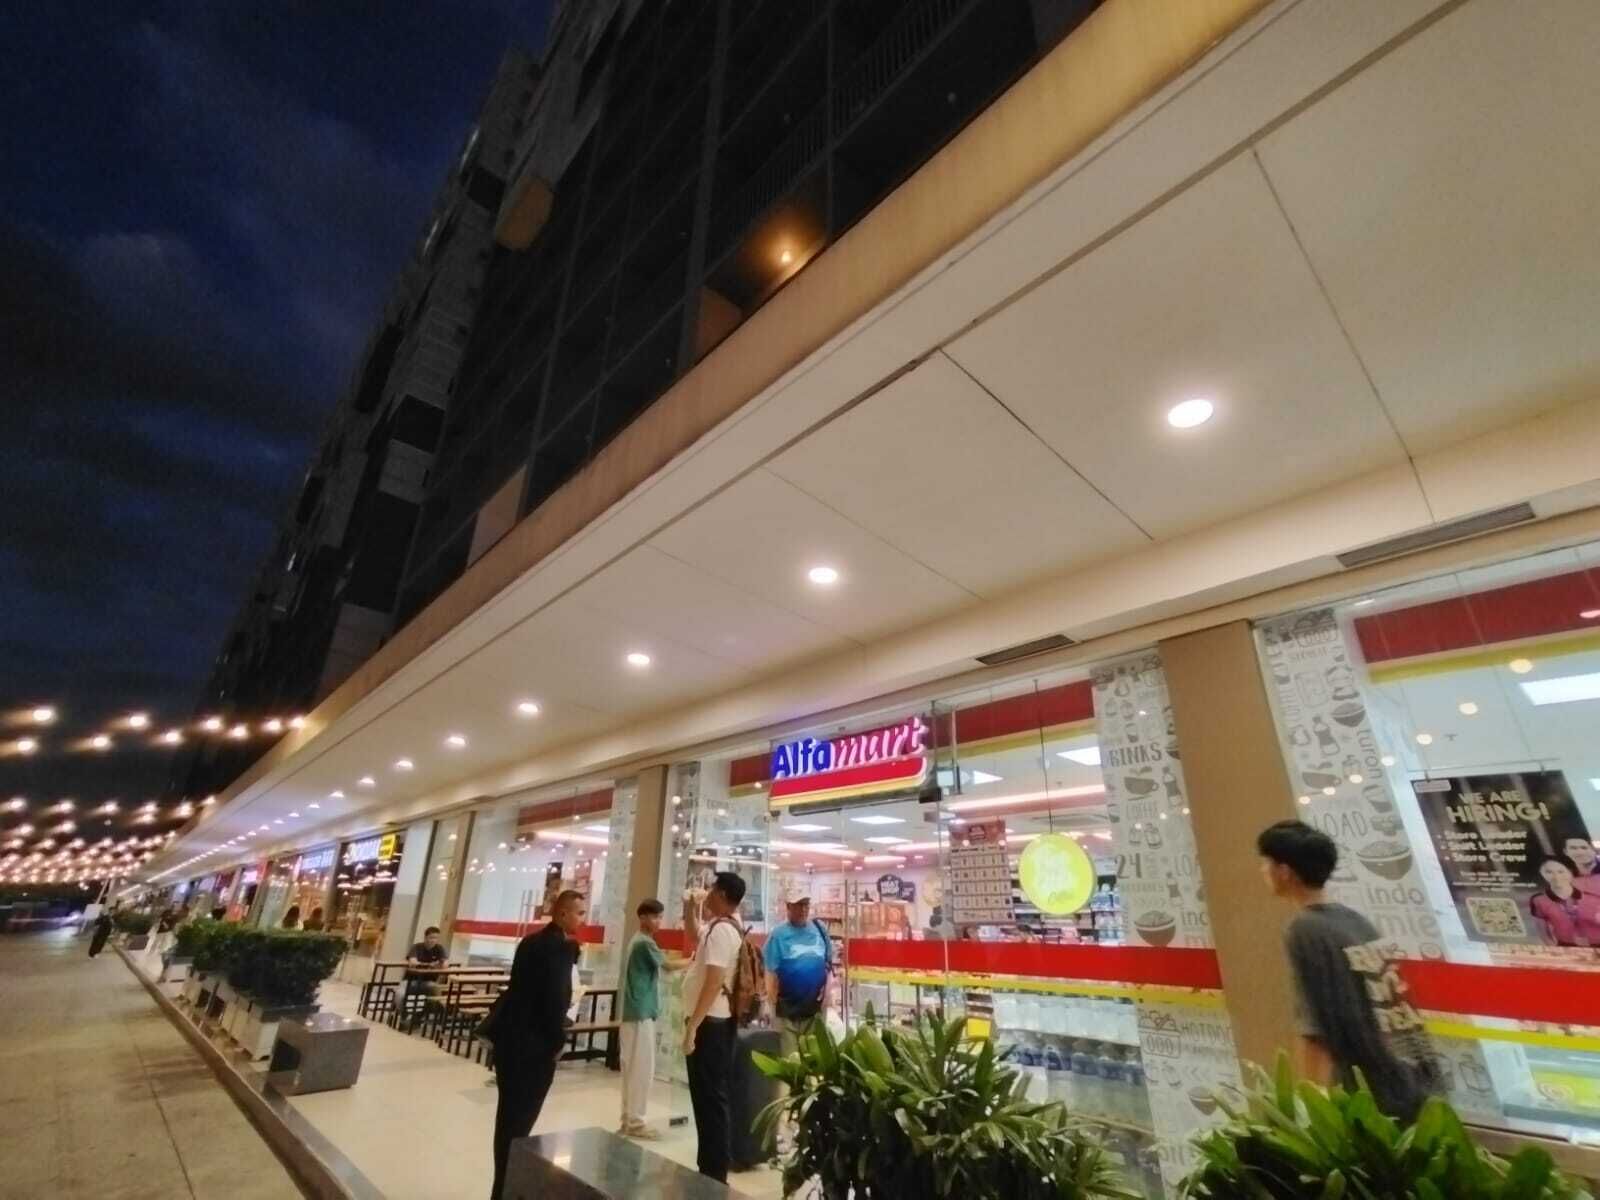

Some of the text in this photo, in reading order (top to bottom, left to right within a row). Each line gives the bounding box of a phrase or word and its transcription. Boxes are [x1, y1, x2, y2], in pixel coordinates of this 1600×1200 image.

[770, 715, 928, 781] Alfamart
[1458, 789, 1522, 804] WE ARE
[1445, 801, 1551, 823] HIRING!
[1115, 853, 1142, 879] 24
